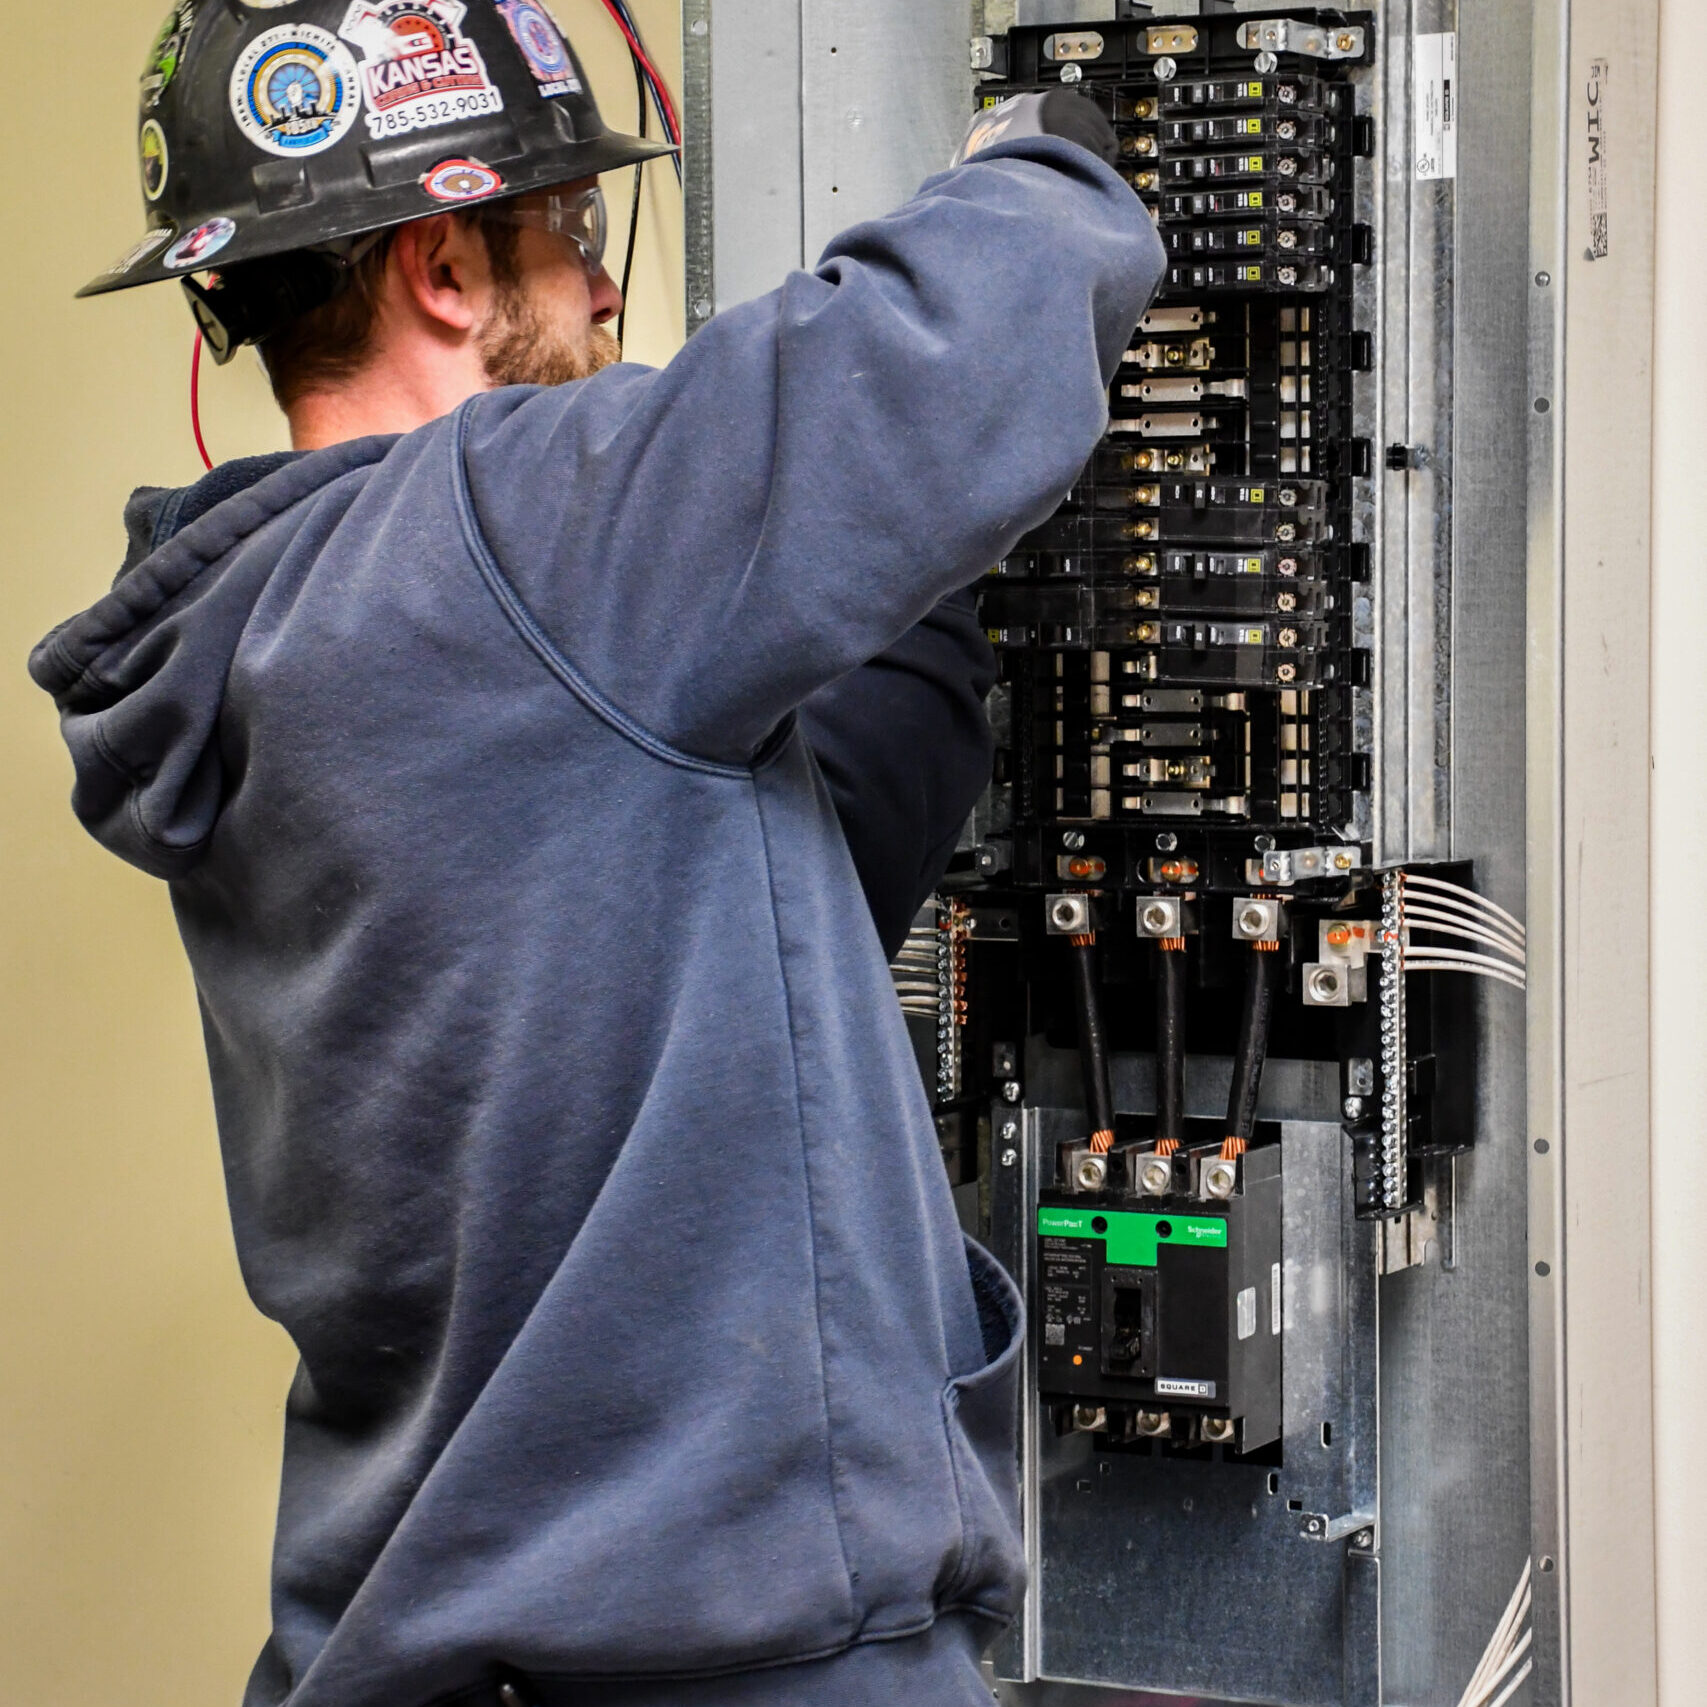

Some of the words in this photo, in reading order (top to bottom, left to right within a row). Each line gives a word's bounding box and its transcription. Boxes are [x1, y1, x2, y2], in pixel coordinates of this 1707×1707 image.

[237, 49, 260, 85] LOCAL
[368, 46, 479, 97] KANSAS
[372, 91, 499, 134] 785-532-9031
[1586, 81, 1600, 165] WIC
[1187, 1225, 1223, 1237] Schneider
[1160, 1383, 1197, 1392] SQUARE
